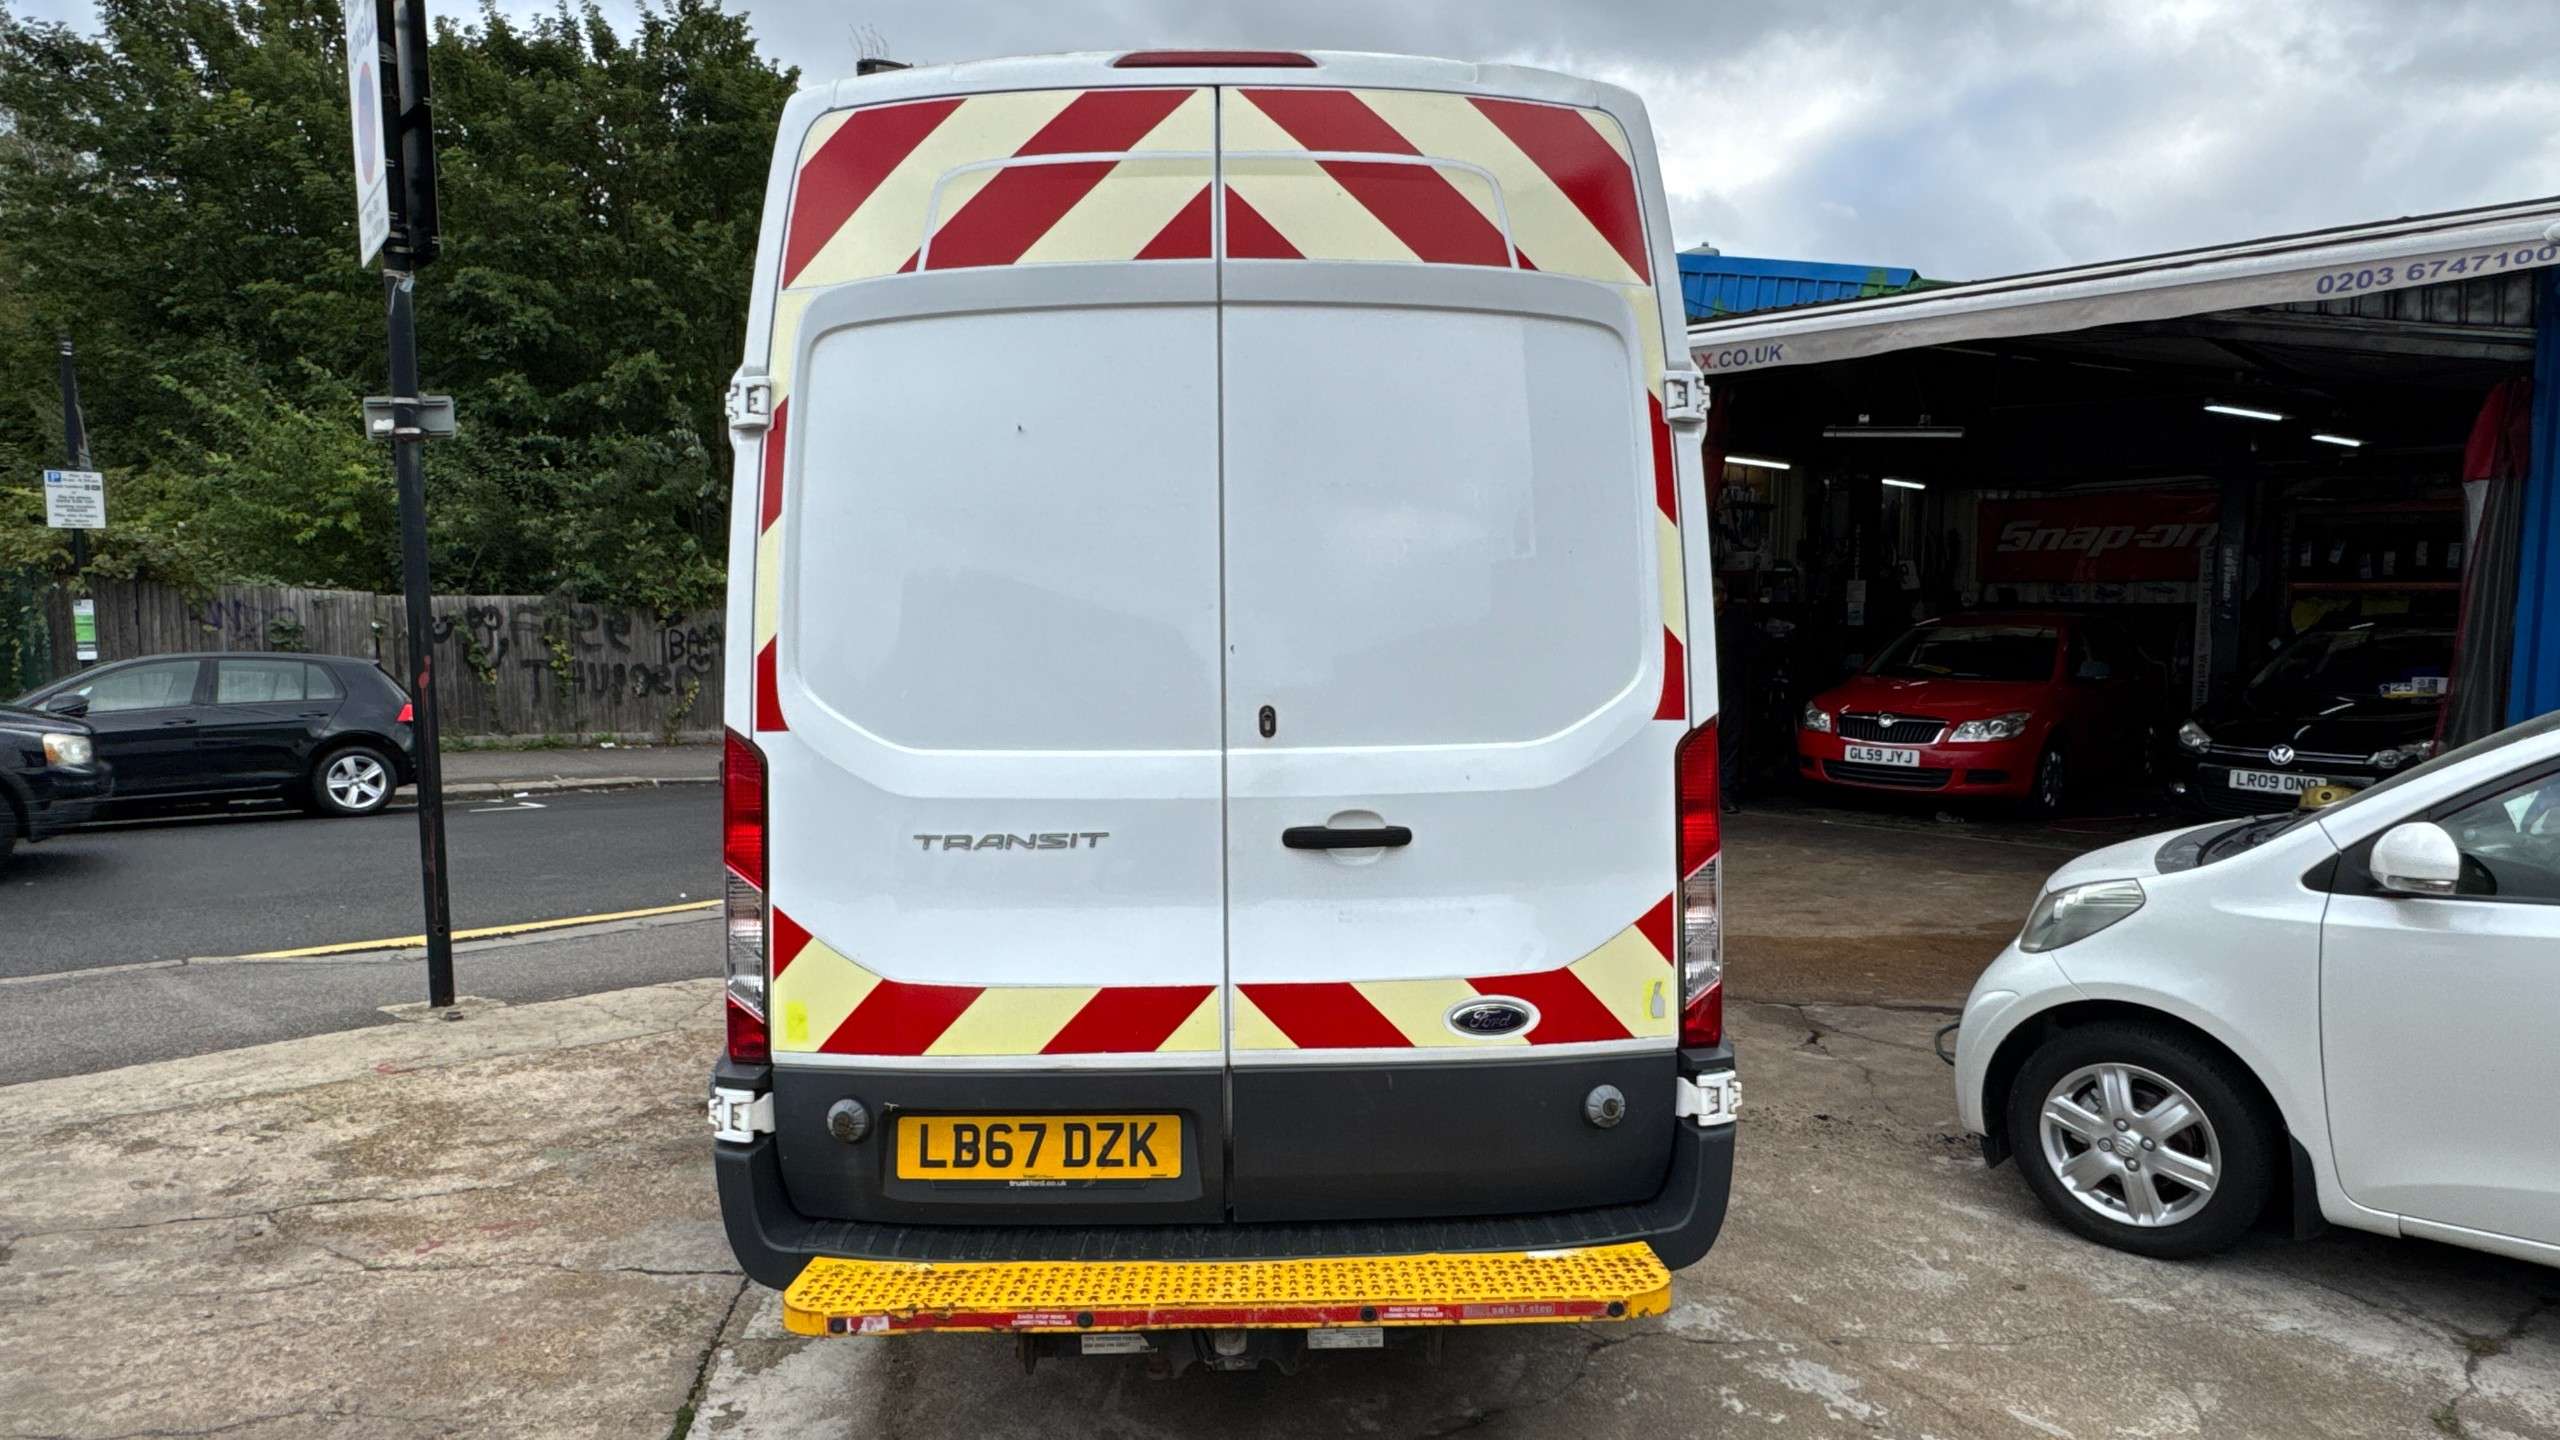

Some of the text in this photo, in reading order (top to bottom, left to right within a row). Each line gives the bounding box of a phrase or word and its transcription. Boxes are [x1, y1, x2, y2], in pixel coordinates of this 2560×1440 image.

[2316, 245, 2557, 295] 0203 6747100
[1996, 519, 2220, 558] Snap-on
[1849, 747, 1913, 764] GL59 JYJ
[2236, 772, 2280, 789] LR09
[912, 832, 1110, 851] TRANSIT
[1469, 1007, 1513, 1029] Ford
[919, 1122, 1159, 1169] LB67 DZK
